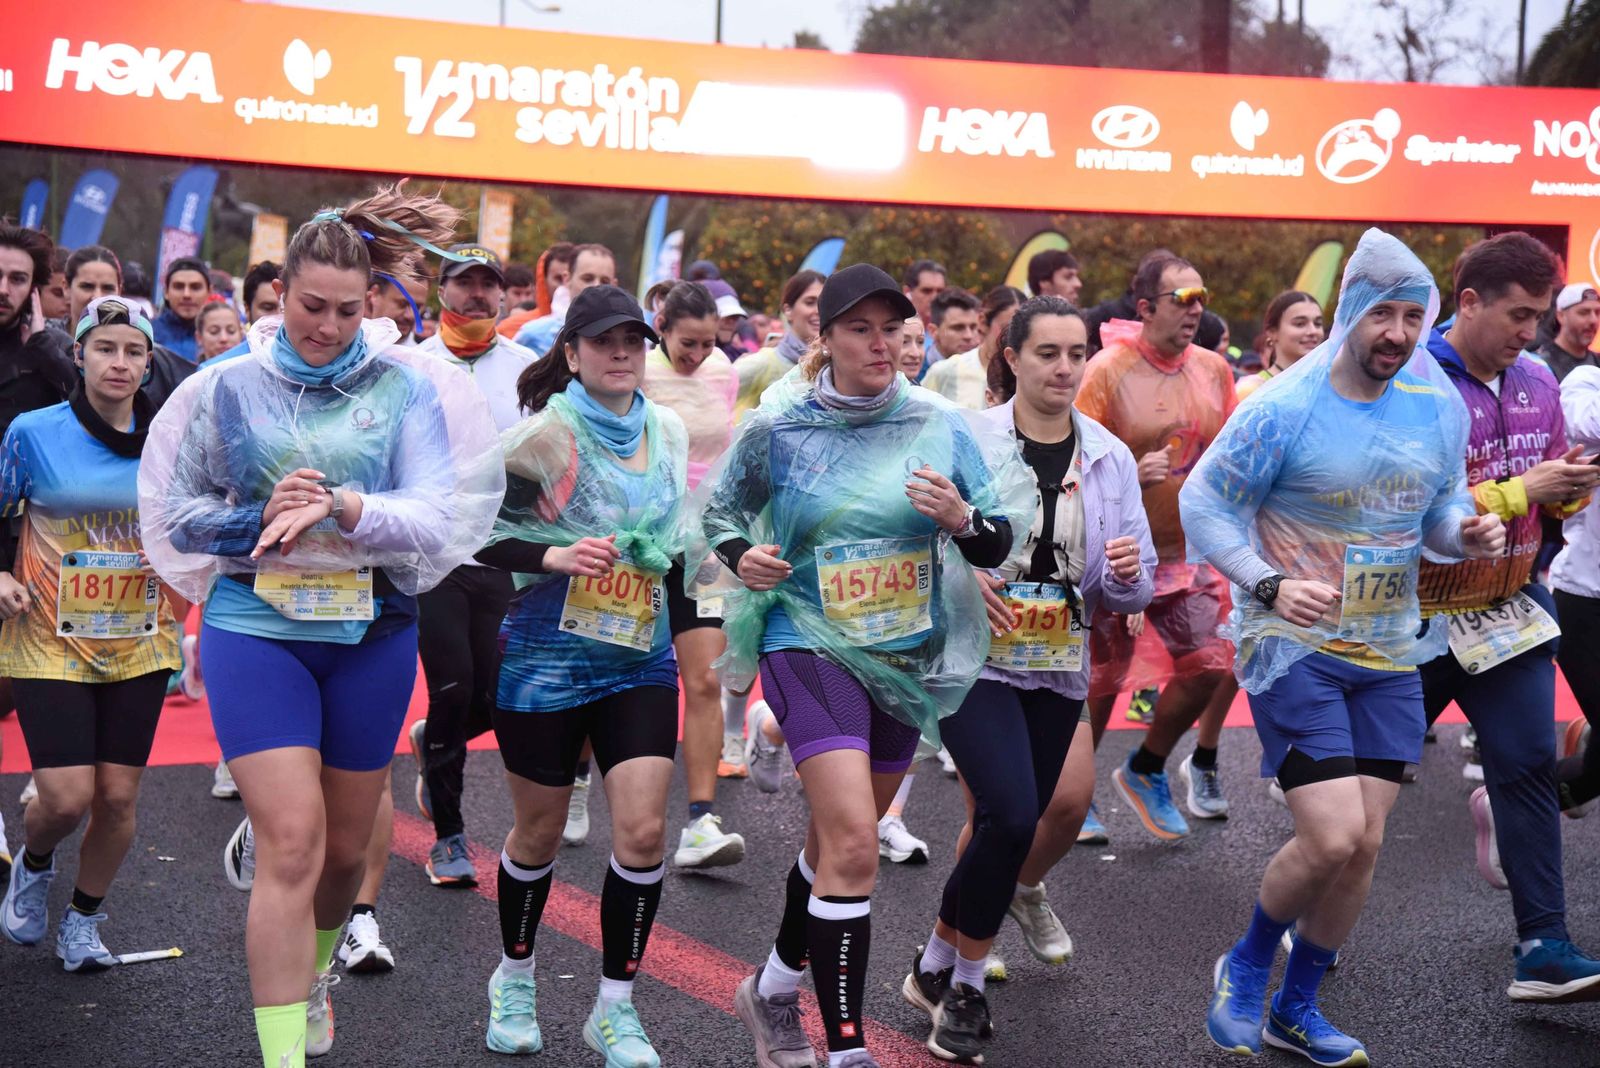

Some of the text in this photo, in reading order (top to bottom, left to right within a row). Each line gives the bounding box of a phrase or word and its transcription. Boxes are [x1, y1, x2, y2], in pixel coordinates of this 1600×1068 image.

[45, 38, 224, 103] HOKA
[457, 61, 680, 113] maratón
[918, 106, 1054, 158] HOKA
[69, 573, 146, 600] 18177
[583, 569, 653, 606] 18076
[830, 560, 917, 602] 15743
